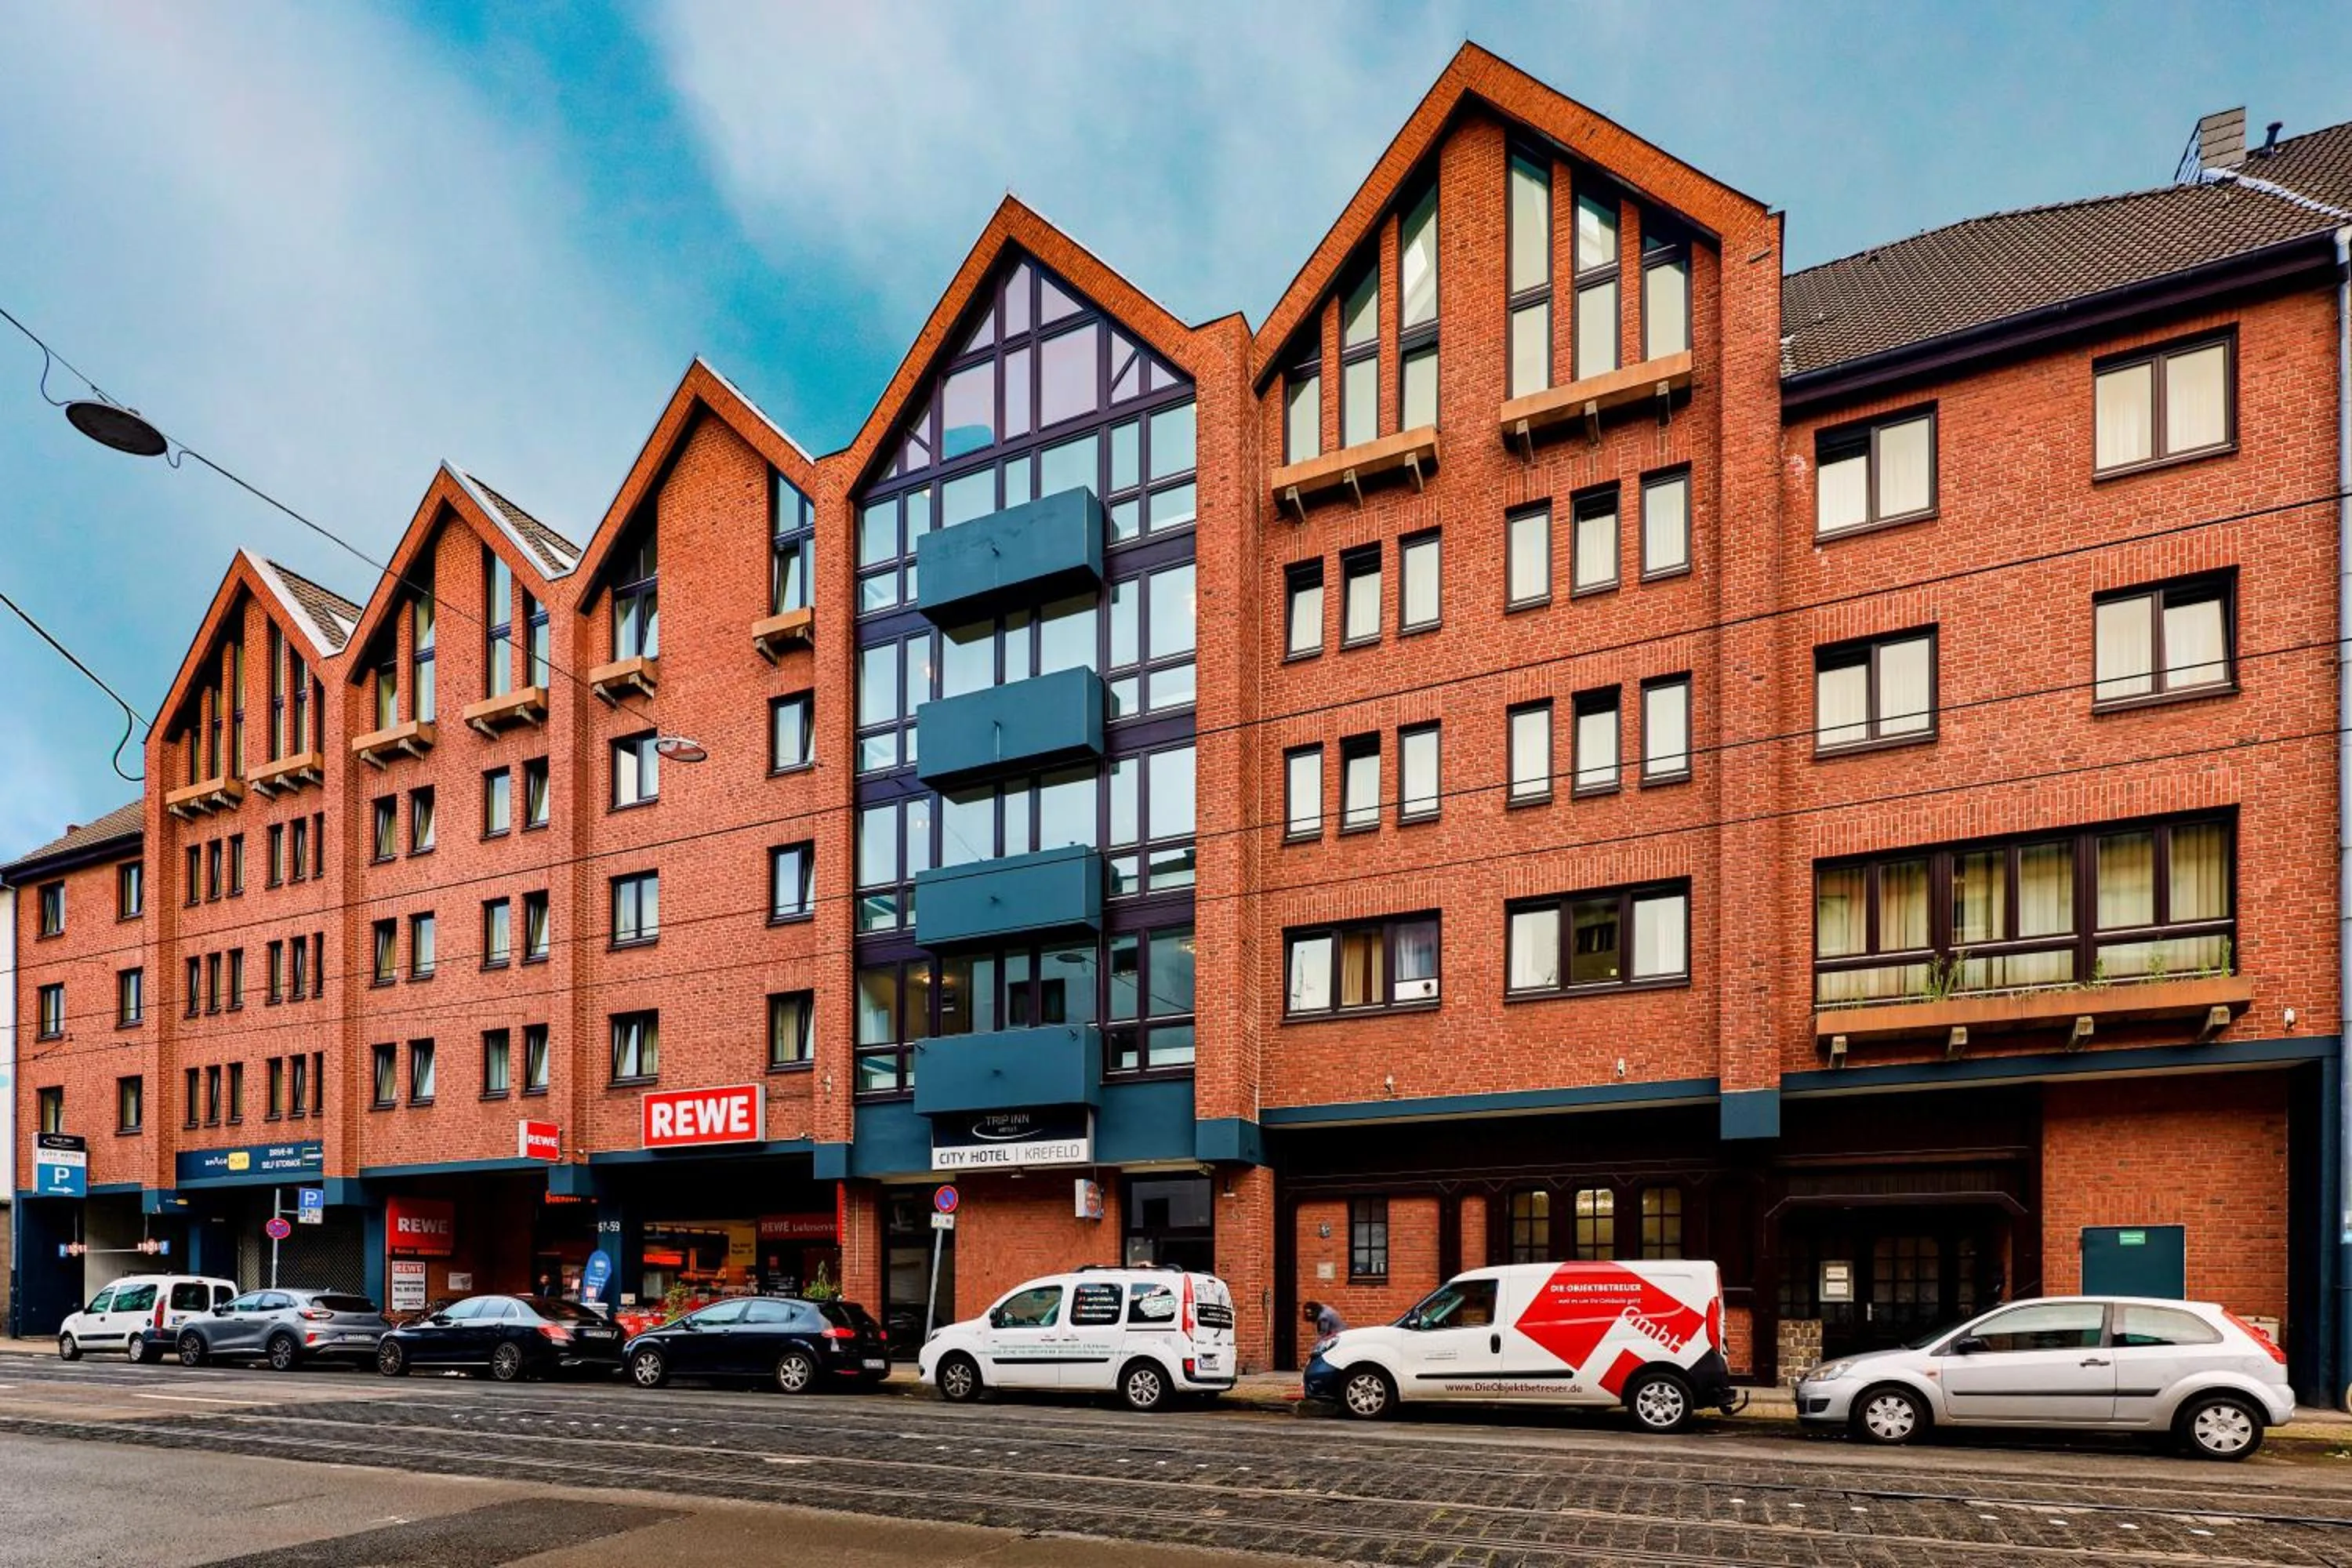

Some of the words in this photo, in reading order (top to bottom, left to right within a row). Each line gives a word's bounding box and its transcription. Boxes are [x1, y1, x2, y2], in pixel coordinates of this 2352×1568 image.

[652, 1095, 750, 1139] REWE
[985, 1115, 1009, 1127] TRIP
[1011, 1113, 1030, 1124] INN
[528, 1134, 558, 1147] REWE
[938, 1152, 965, 1164] CITY
[970, 1149, 1010, 1163] HOTEL
[1025, 1144, 1080, 1160] KREFELD
[54, 1167, 70, 1185] P
[305, 1191, 318, 1207] P
[397, 1216, 448, 1234] REWE
[761, 1221, 789, 1233] REWE
[793, 1222, 838, 1232] Lieferservic
[1550, 1284, 1565, 1293] DIE
[1566, 1283, 1642, 1293] OBJEKTBETREUER
[1445, 1382, 1583, 1394] www.DieObjektbetreuer.de
